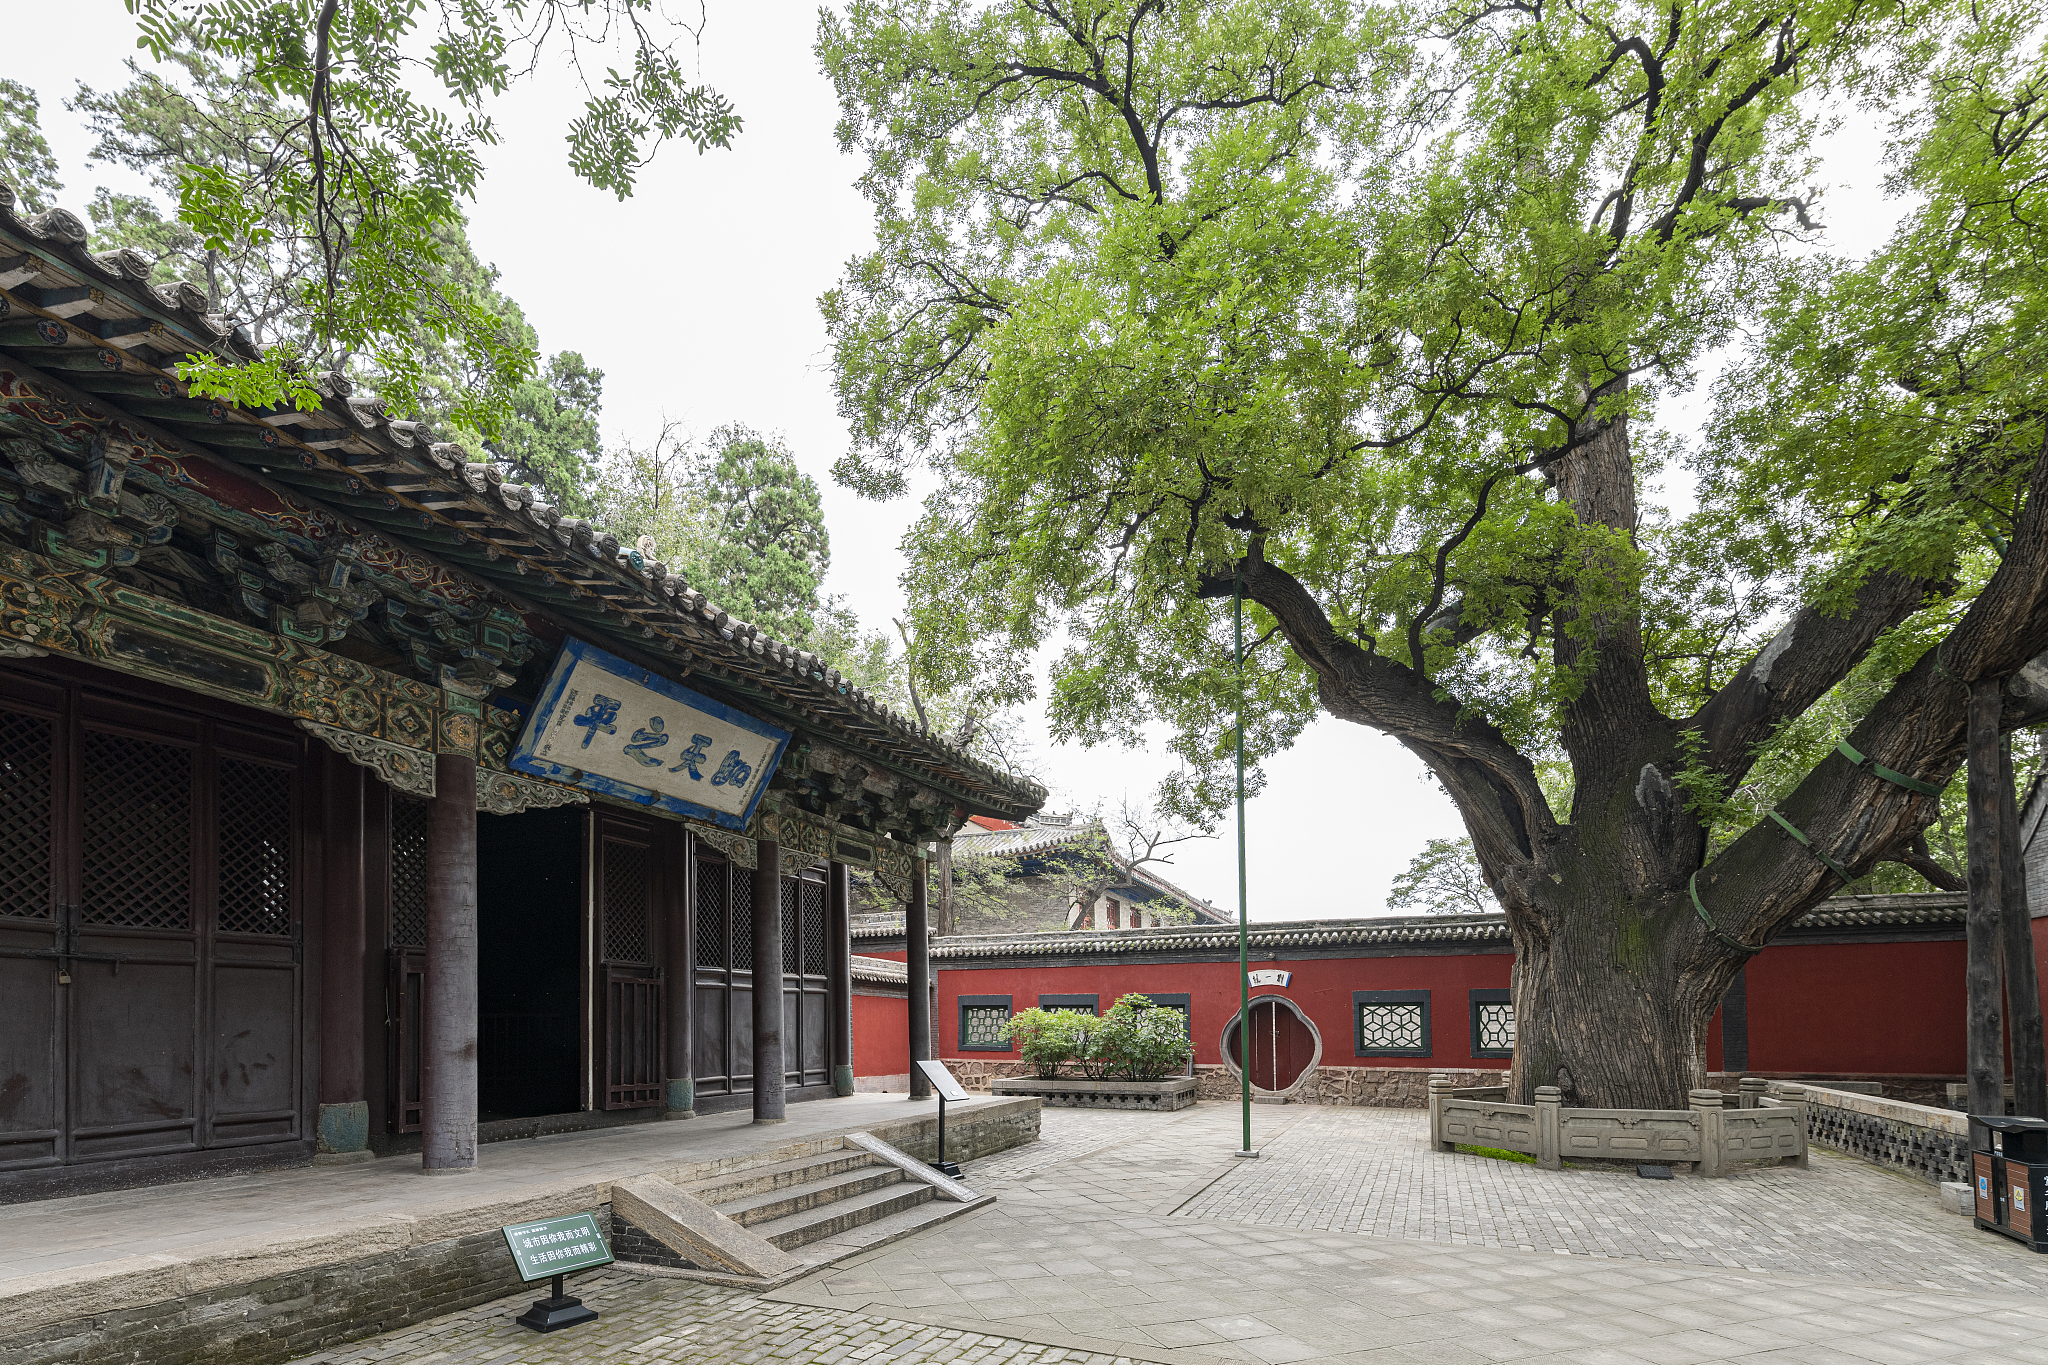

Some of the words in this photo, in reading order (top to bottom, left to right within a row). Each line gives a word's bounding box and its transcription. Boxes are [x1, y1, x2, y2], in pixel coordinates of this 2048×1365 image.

[522, 1226, 591, 1249] 城市因你我而文明
[530, 1241, 598, 1265] 生活因你我而精彩
